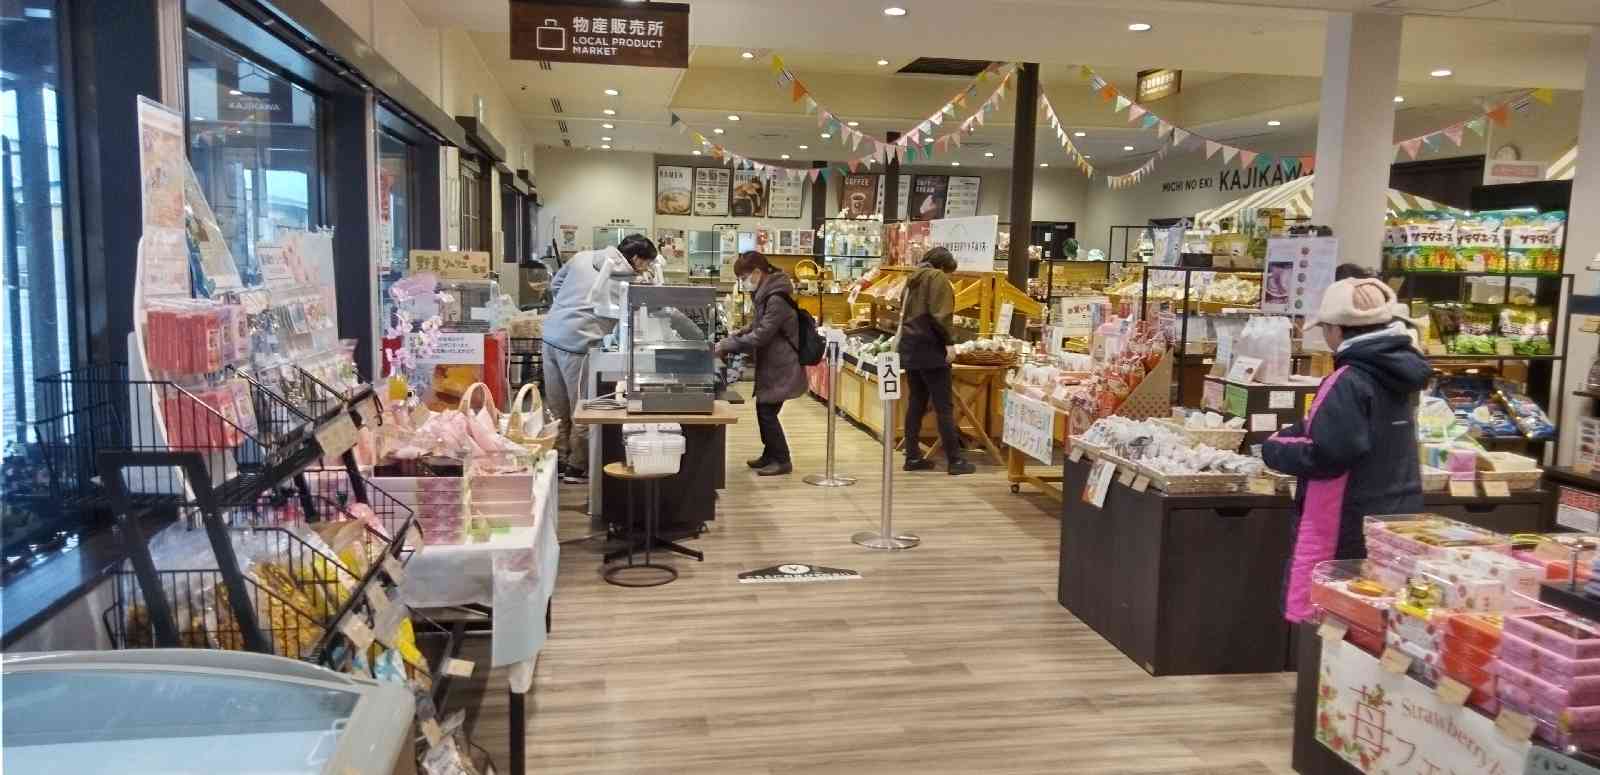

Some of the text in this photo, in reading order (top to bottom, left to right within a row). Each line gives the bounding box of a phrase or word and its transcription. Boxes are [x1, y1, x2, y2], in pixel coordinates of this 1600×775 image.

[572, 16, 664, 37] 物産販売所
[572, 37, 663, 49] LOCAL PRODUCT
[572, 47, 617, 56] MARKET
[844, 177, 870, 186] COFFEE
[1185, 179, 1197, 191] NO
[1199, 178, 1213, 189] EKI
[1219, 162, 1314, 192] KAJIKAW
[883, 364, 897, 392] 入口
